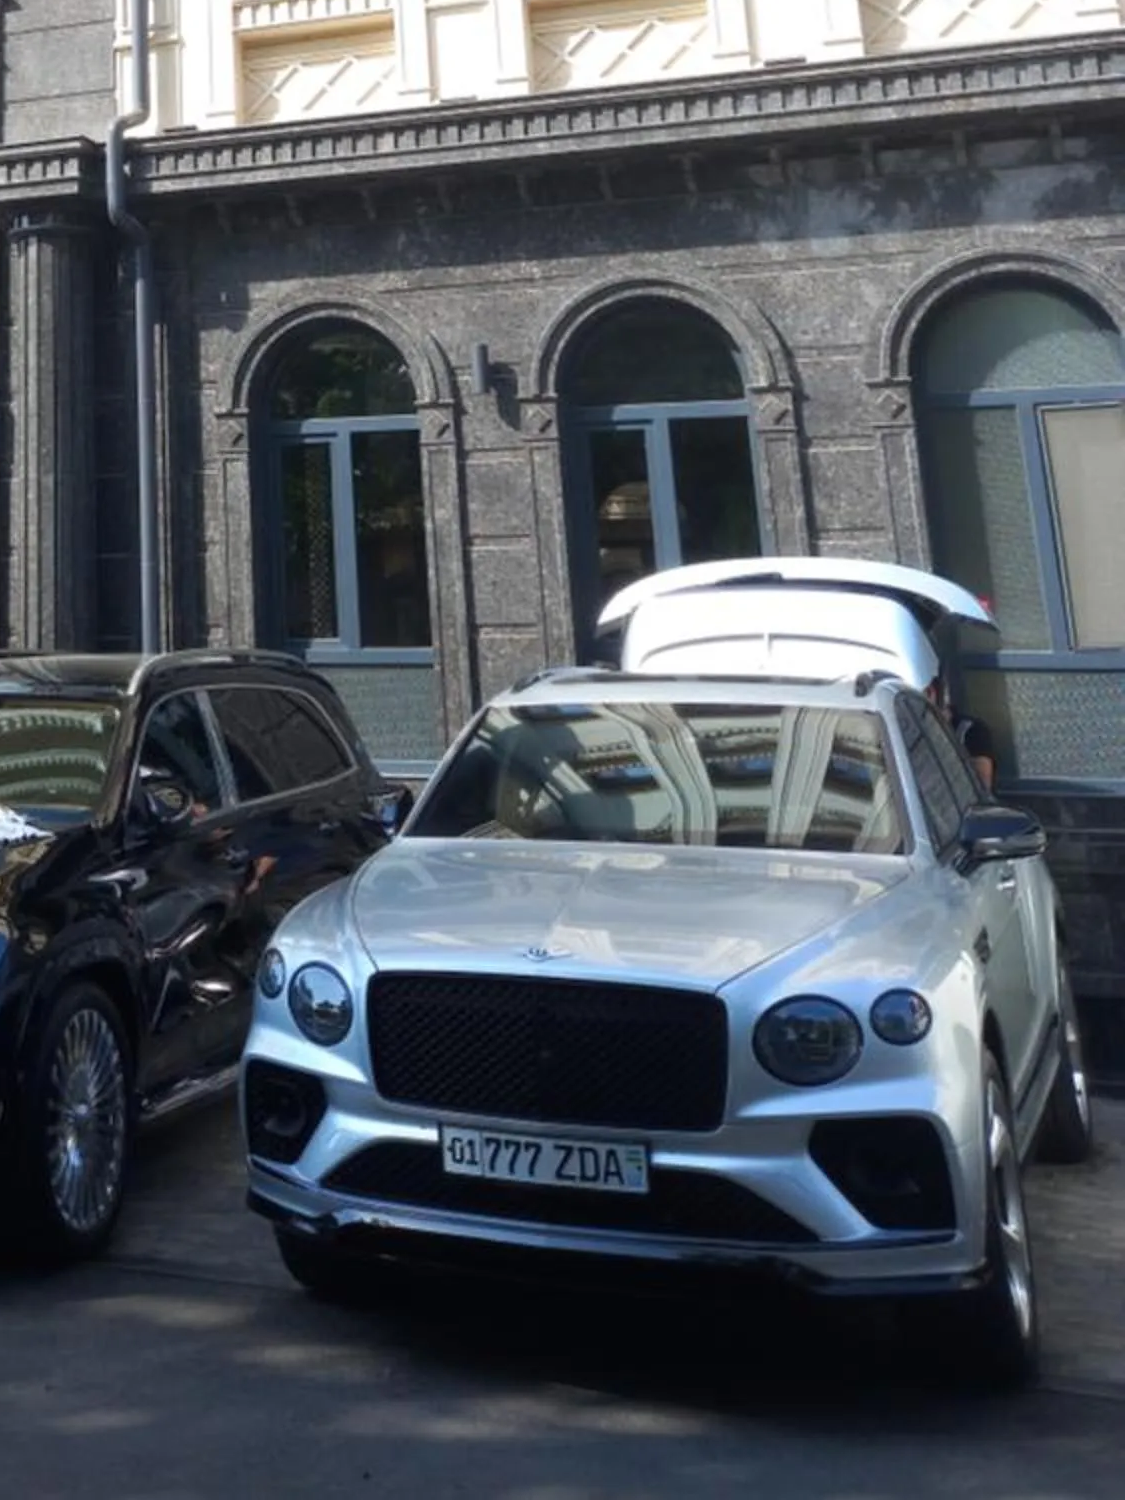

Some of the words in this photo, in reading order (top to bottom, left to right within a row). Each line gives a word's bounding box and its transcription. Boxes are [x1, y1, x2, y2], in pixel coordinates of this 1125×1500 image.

[447, 1136, 479, 1166] 01
[484, 1137, 543, 1178] 777
[553, 1145, 625, 1186] ZDA
